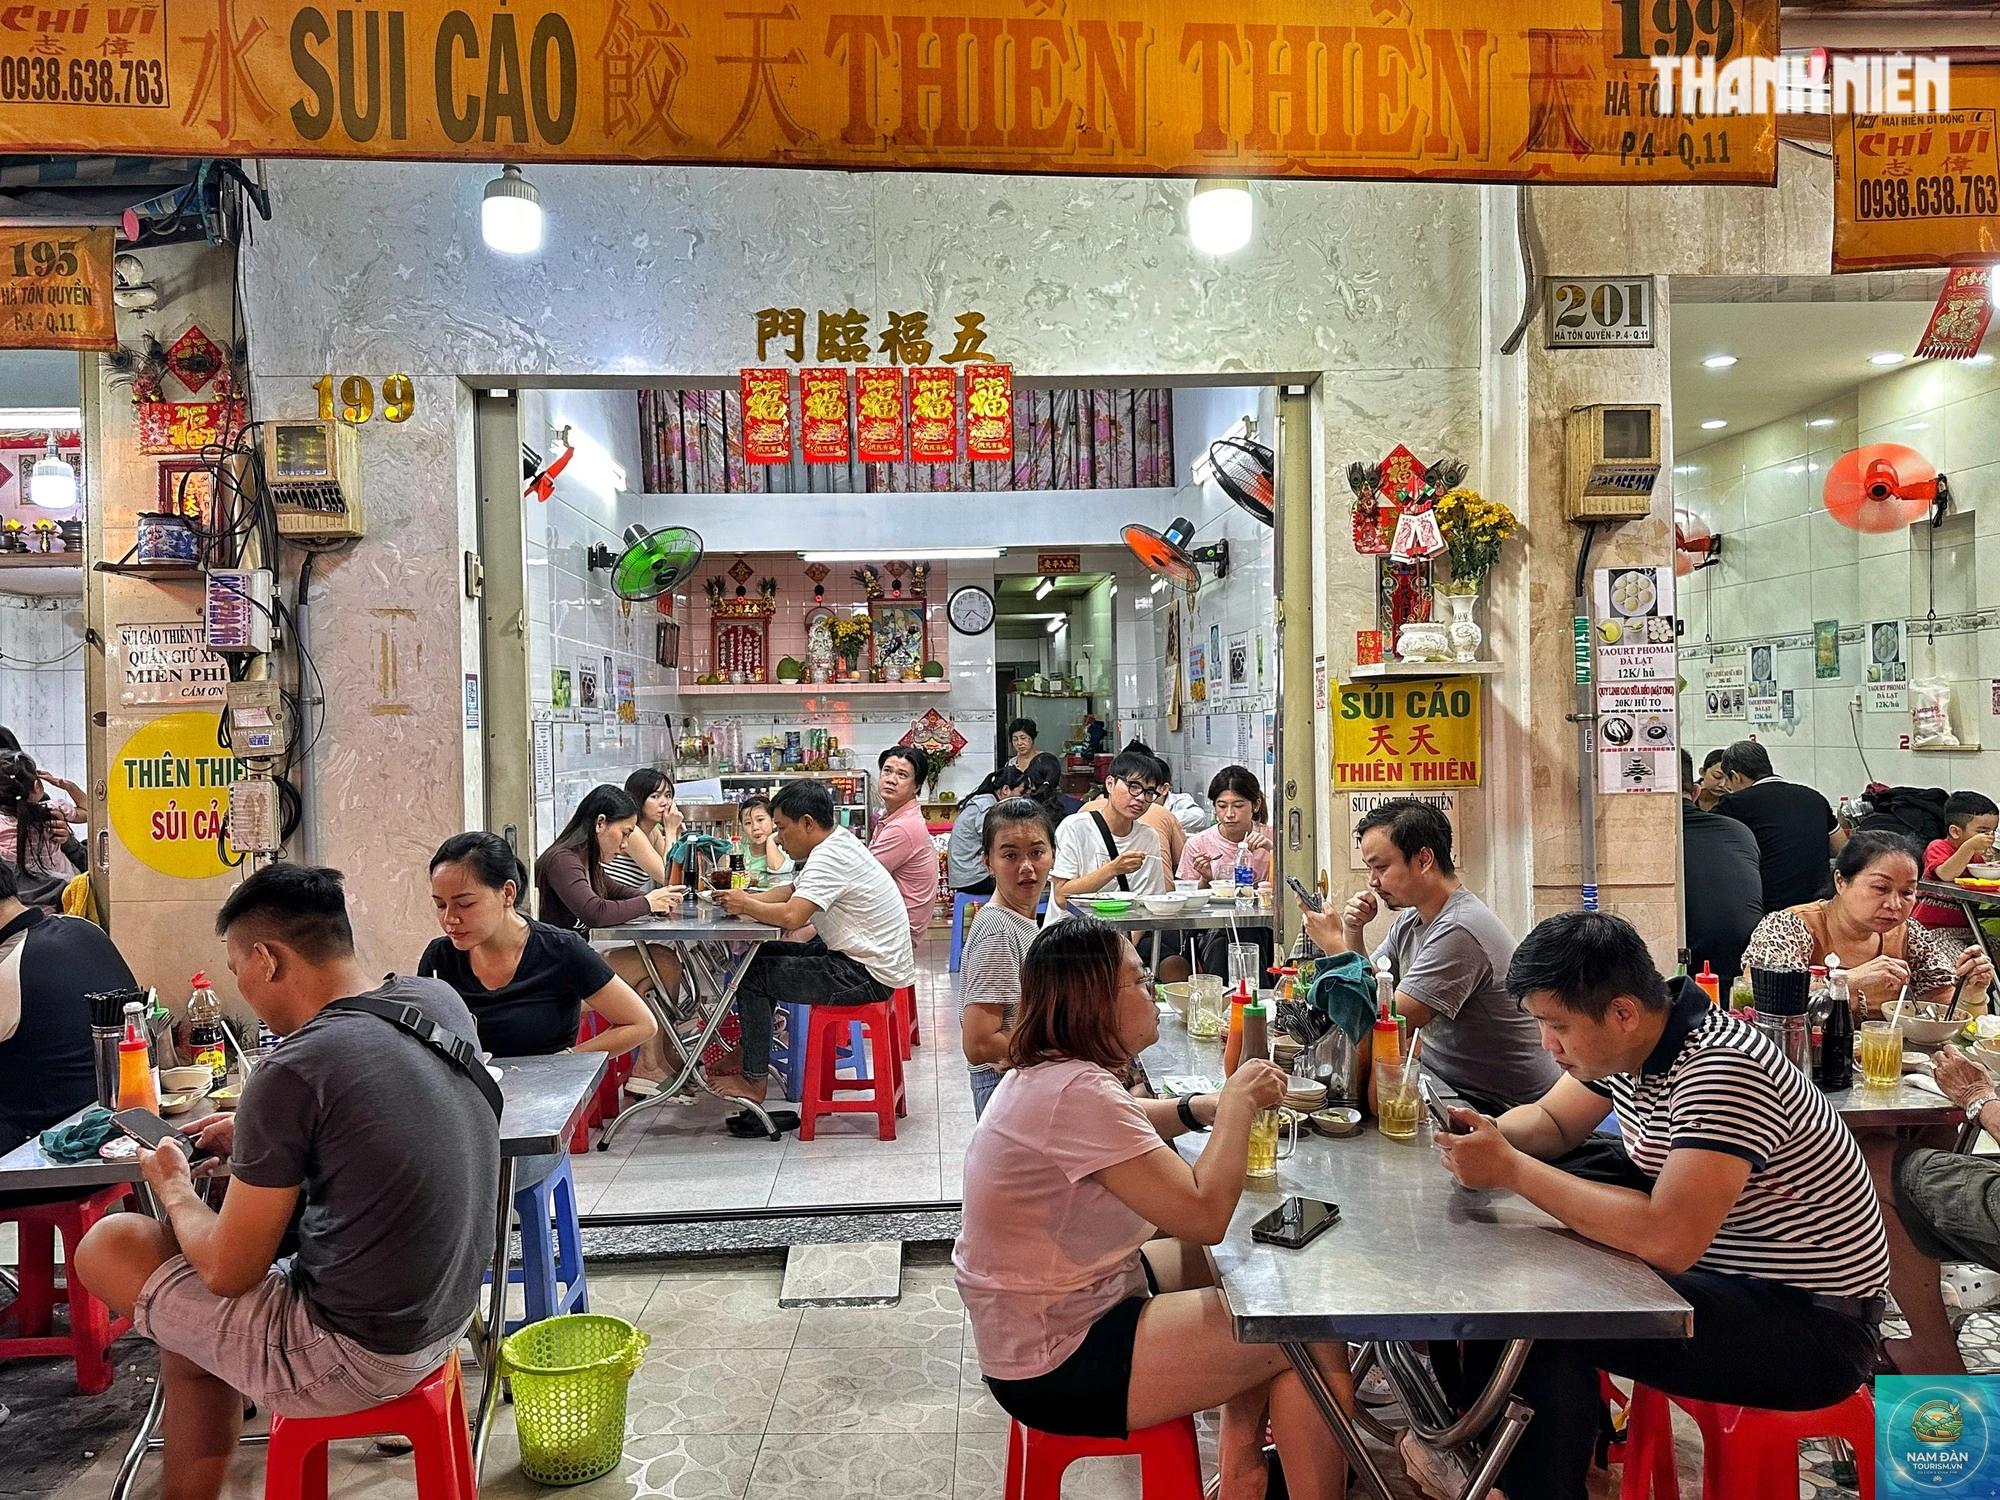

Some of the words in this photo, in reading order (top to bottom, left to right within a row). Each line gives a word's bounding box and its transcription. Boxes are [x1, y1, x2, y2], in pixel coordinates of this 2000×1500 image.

[1, 3, 90, 33] CHÍ
[107, 2, 160, 34] VĨ
[1612, 0, 1735, 61] 199
[1, 56, 164, 105] 0938.638.763
[1179, 0, 1494, 157] THIÊN
[1604, 71, 1630, 116] HÀ
[1620, 131, 1654, 166] P.4
[1678, 131, 1730, 170] Q.11
[1858, 127, 1933, 156] CHÍ
[1948, 126, 1992, 153] VĨ
[1860, 175, 1998, 218] 0938.638.763
[10, 241, 79, 277] 195
[14, 312, 34, 331] P.4
[46, 312, 76, 334] Q.11
[1556, 284, 1647, 328] 201
[312, 374, 415, 424] 199
[201, 650, 219, 662] XE
[1598, 647, 1636, 656] YAOURT
[1637, 645, 1674, 655] PHOMAI
[1620, 656, 1633, 665] ĐÀ
[1635, 656, 1653, 666] LẠT
[189, 664, 226, 681] PHÍ
[1341, 683, 1395, 719] SỦI
[1406, 682, 1471, 718] CẢO
[1649, 698, 1662, 706] TO
[1899, 735, 1910, 749] 2
[124, 752, 190, 788] THIÊN
[1337, 759, 1403, 782] THIÊN
[1410, 757, 1476, 781] THIÊN
[151, 800, 188, 841] SỦI
